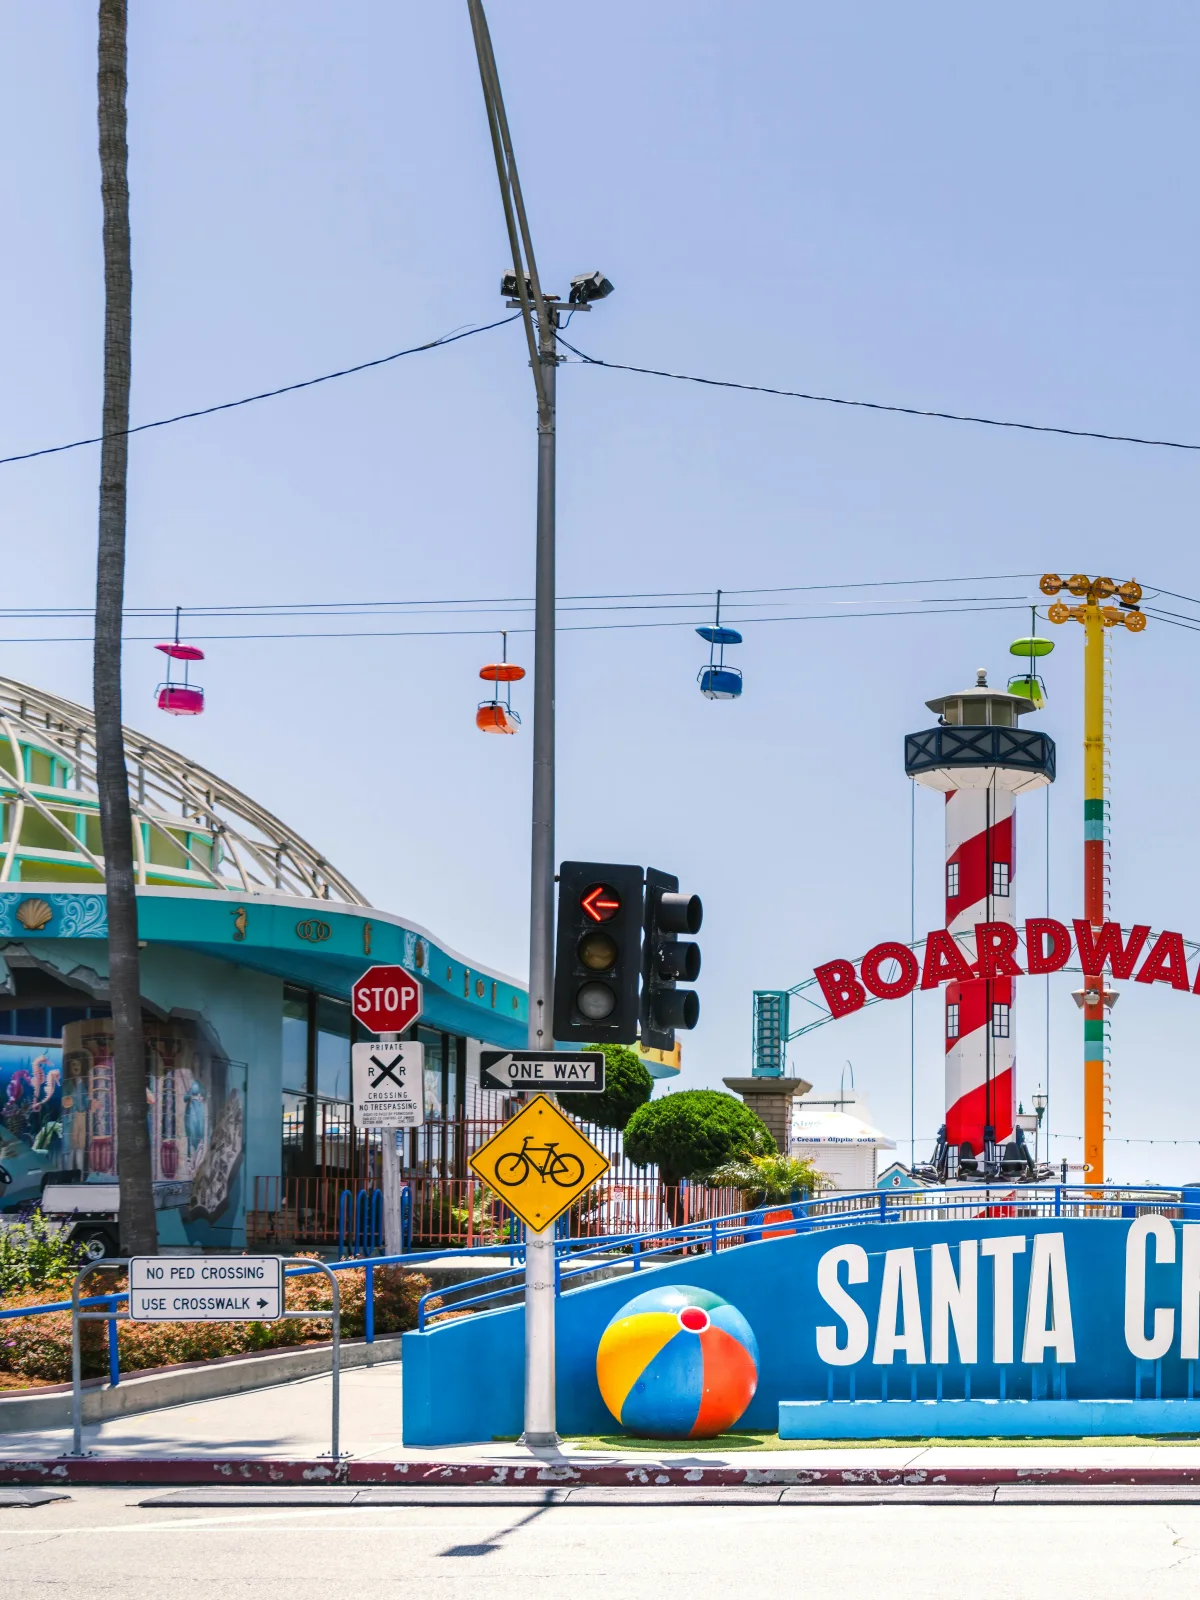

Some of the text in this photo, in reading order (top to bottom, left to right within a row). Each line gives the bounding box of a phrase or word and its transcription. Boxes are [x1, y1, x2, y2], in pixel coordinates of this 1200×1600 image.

[357, 986, 415, 1012] STOP
[370, 1043, 404, 1051] PRIVATE
[368, 1066, 406, 1077] R R
[508, 1063, 591, 1079] ONE WAY
[368, 1091, 408, 1100] CROSSING
[359, 1102, 418, 1112] NO TRESPASSING
[146, 1266, 265, 1280] NO PED CROSSING
[141, 1297, 250, 1311] USE CROSSWALK
[815, 1230, 1077, 1366] SANTA
